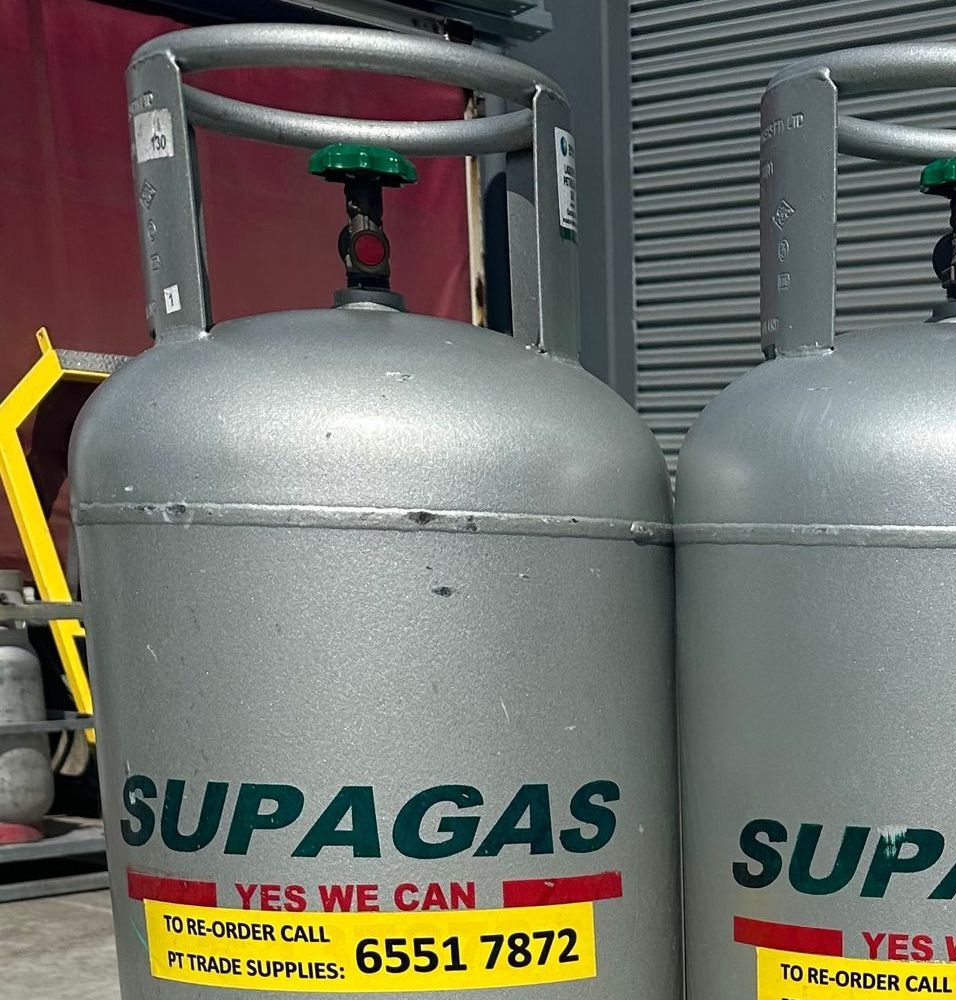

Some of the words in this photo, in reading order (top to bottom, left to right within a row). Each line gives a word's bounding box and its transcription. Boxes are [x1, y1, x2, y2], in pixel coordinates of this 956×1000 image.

[120, 774, 621, 859] SUPAGAS
[235, 883, 307, 912] YES
[318, 884, 380, 912] WE
[394, 882, 476, 911] CAN
[163, 914, 184, 935] TO
[187, 918, 277, 943] RE-ORDER
[280, 923, 331, 943] CALL
[355, 936, 467, 974] 6551
[480, 928, 580, 970] 7872
[862, 931, 933, 961] YES
[168, 951, 185, 969] PT
[185, 953, 243, 976] TRADE
[246, 959, 345, 980] SUPPLIES:
[780, 963, 804, 982] TO
[808, 967, 900, 992] RE-ORDER
[905, 975, 953, 994] CALL
